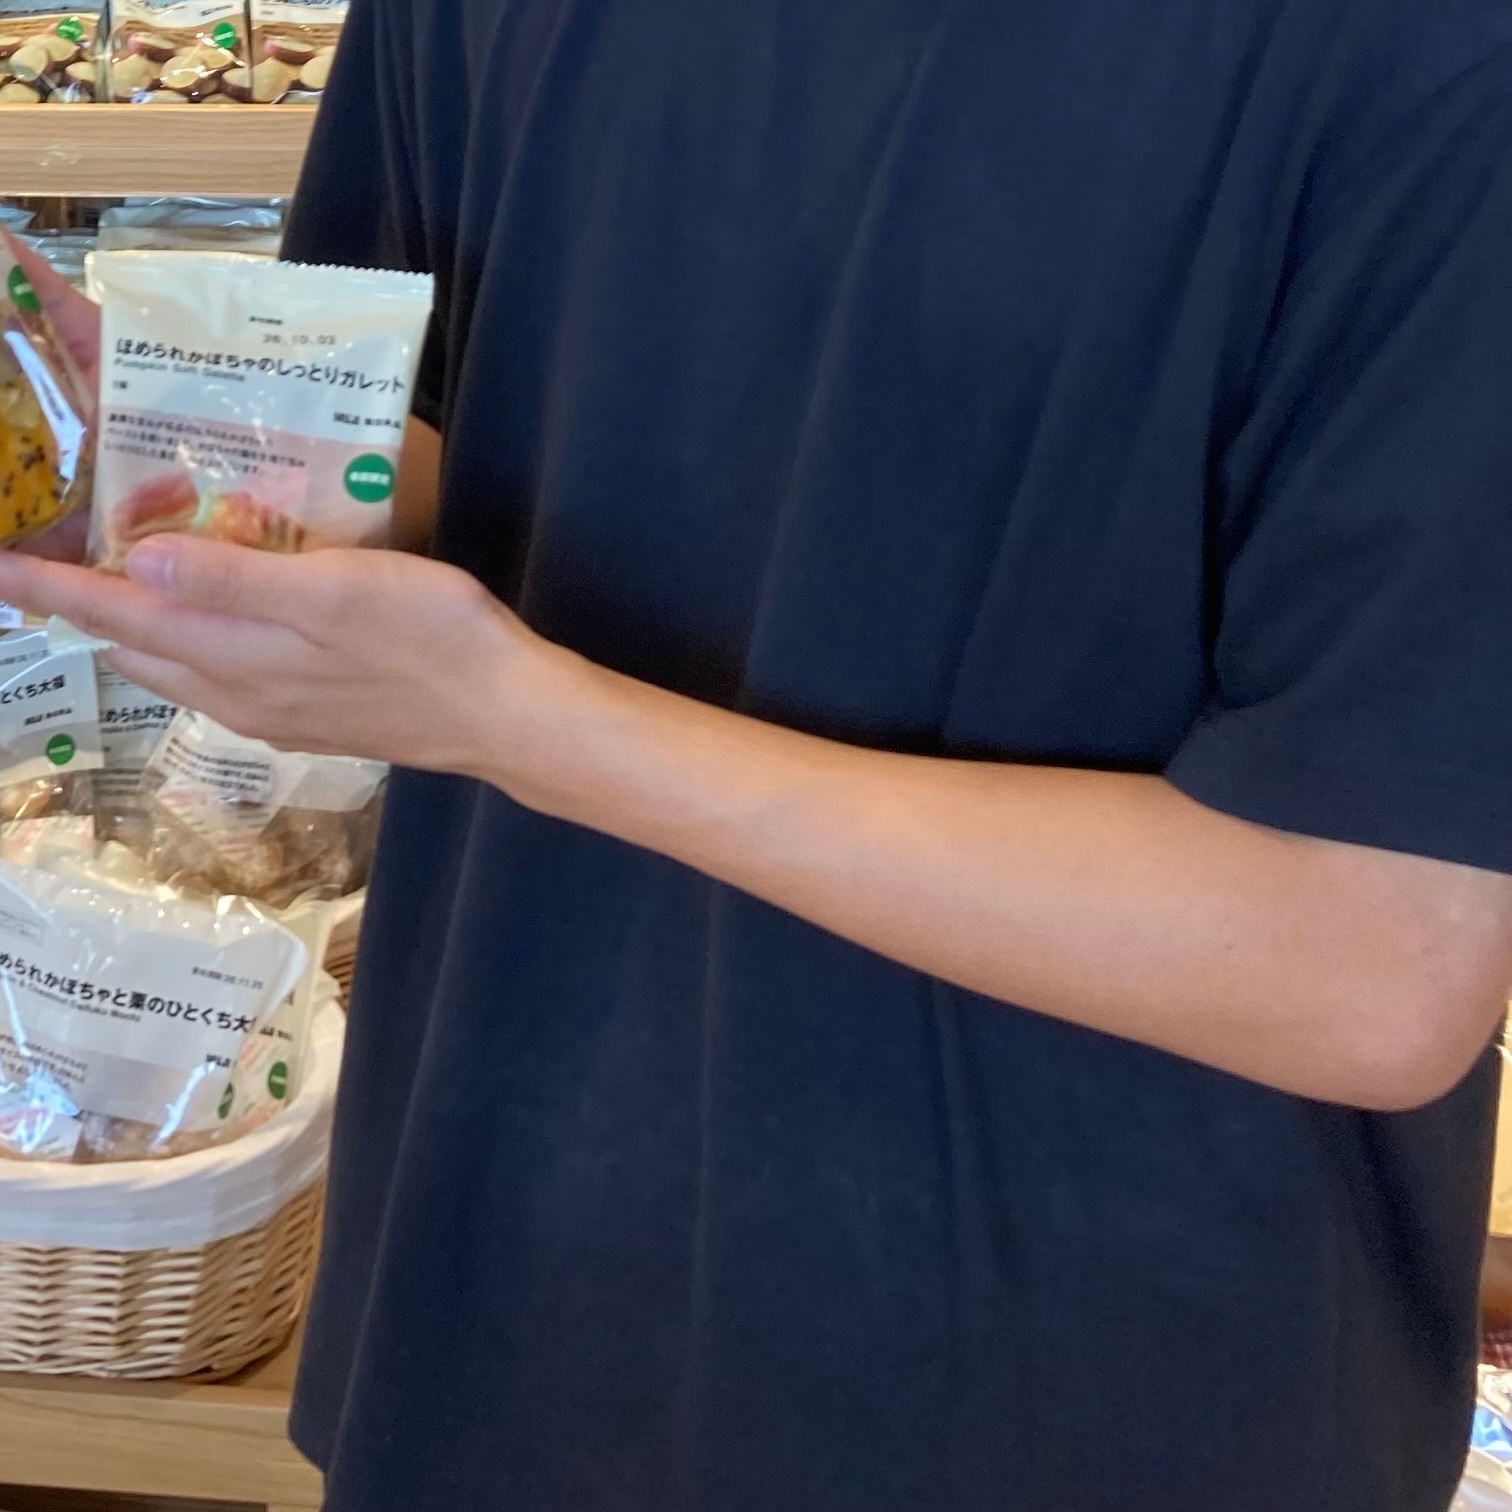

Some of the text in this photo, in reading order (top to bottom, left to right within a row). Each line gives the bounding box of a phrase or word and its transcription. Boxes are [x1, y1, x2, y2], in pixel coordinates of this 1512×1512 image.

[115, 338, 405, 394] ほめられかぼちゃのしっとりガレット
